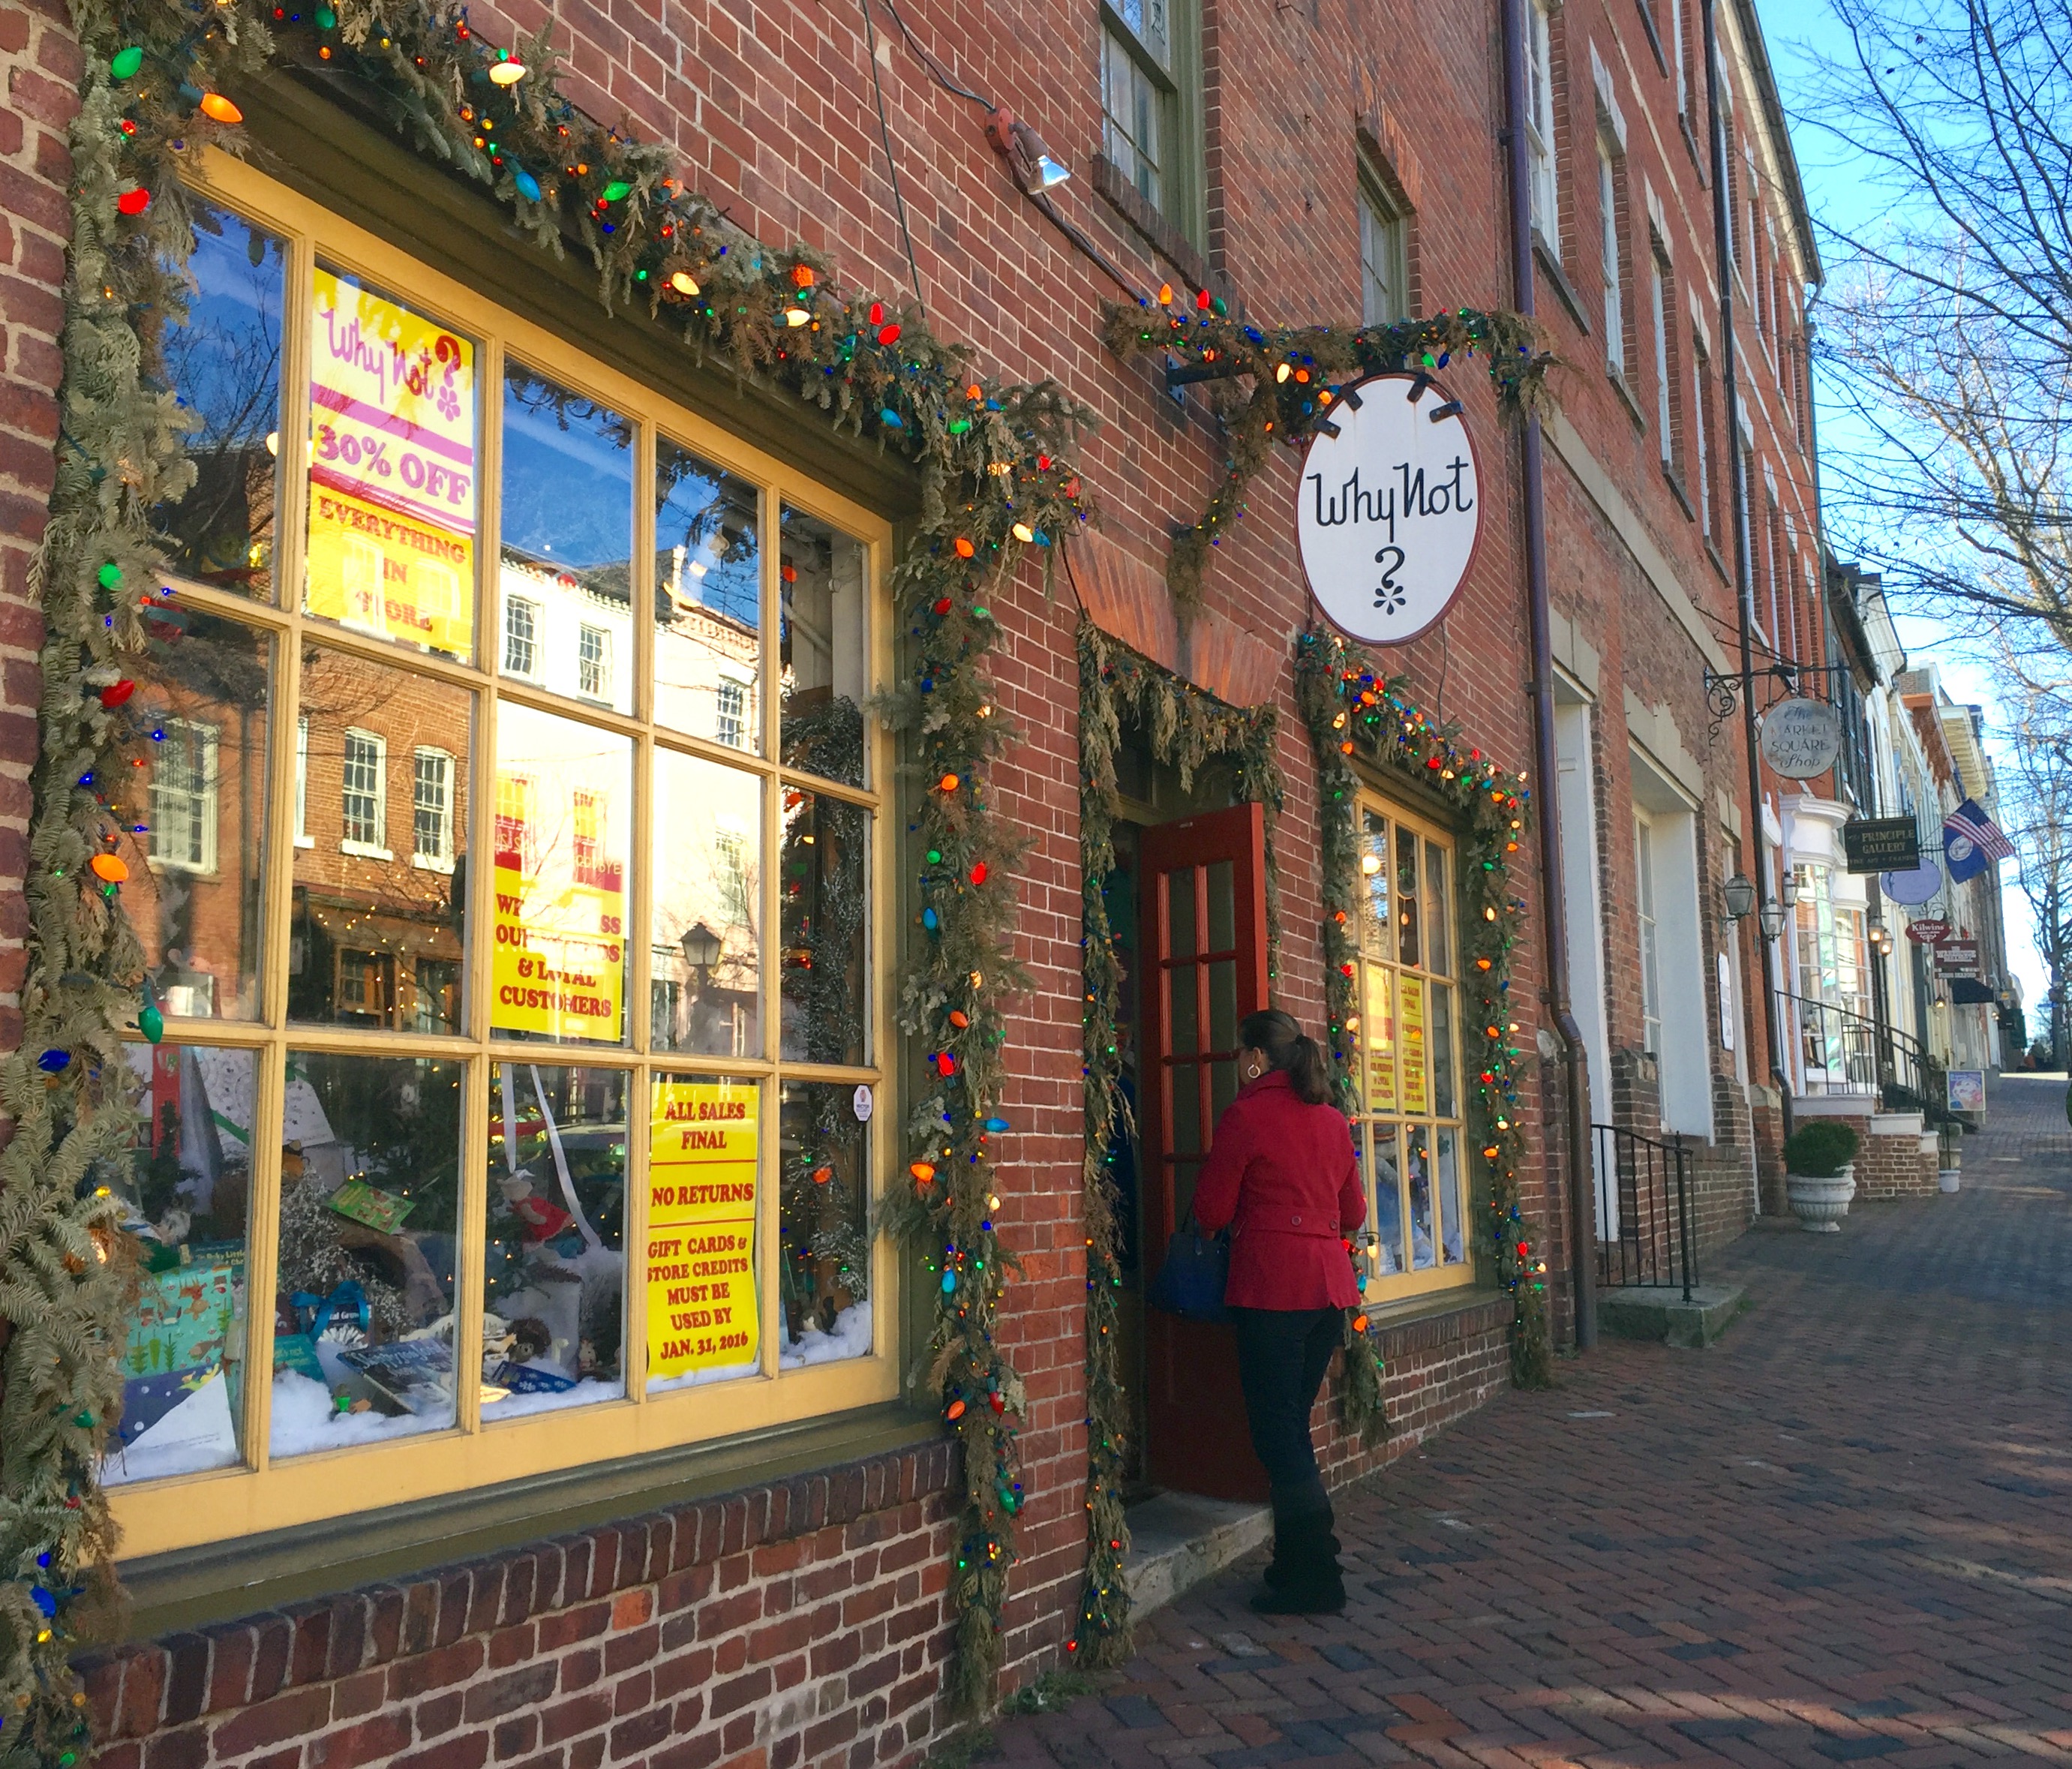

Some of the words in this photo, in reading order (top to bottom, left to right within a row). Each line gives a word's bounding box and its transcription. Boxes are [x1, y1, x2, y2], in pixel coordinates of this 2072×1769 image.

[317, 424, 392, 477] 30%
[399, 452, 471, 505] OFF
[1306, 466, 1395, 543] Why
[1392, 455, 1473, 518] Not
[318, 495, 467, 564] EVERYTHING
[383, 557, 409, 584] IN
[1770, 724, 1830, 737] ARKET
[1771, 738, 1831, 752] SQUARE
[1780, 753, 1820, 768] Shop
[1861, 829, 1916, 842] PRINCIPLE
[1862, 842, 1906, 854] GALLERY
[518, 957, 534, 978] &
[500, 984, 612, 1018] CUSTOMERS
[665, 1101, 698, 1121] ALL
[698, 1101, 746, 1121] SALES
[681, 1130, 727, 1150] FINAL
[651, 1187, 674, 1207] NO
[677, 1182, 754, 1206] RETURNS
[648, 1239, 682, 1259] GIFT
[687, 1235, 735, 1255] CARDS
[737, 1237, 747, 1249] &
[647, 1263, 689, 1282] STORE
[692, 1257, 749, 1278] CREDITS
[667, 1284, 708, 1305] MUST
[710, 1282, 730, 1300] BE
[671, 1309, 712, 1332] USED
[715, 1306, 732, 1326] BY
[660, 1338, 694, 1360] JAN.
[697, 1335, 716, 1356] 31,
[719, 1330, 749, 1350] 2016
